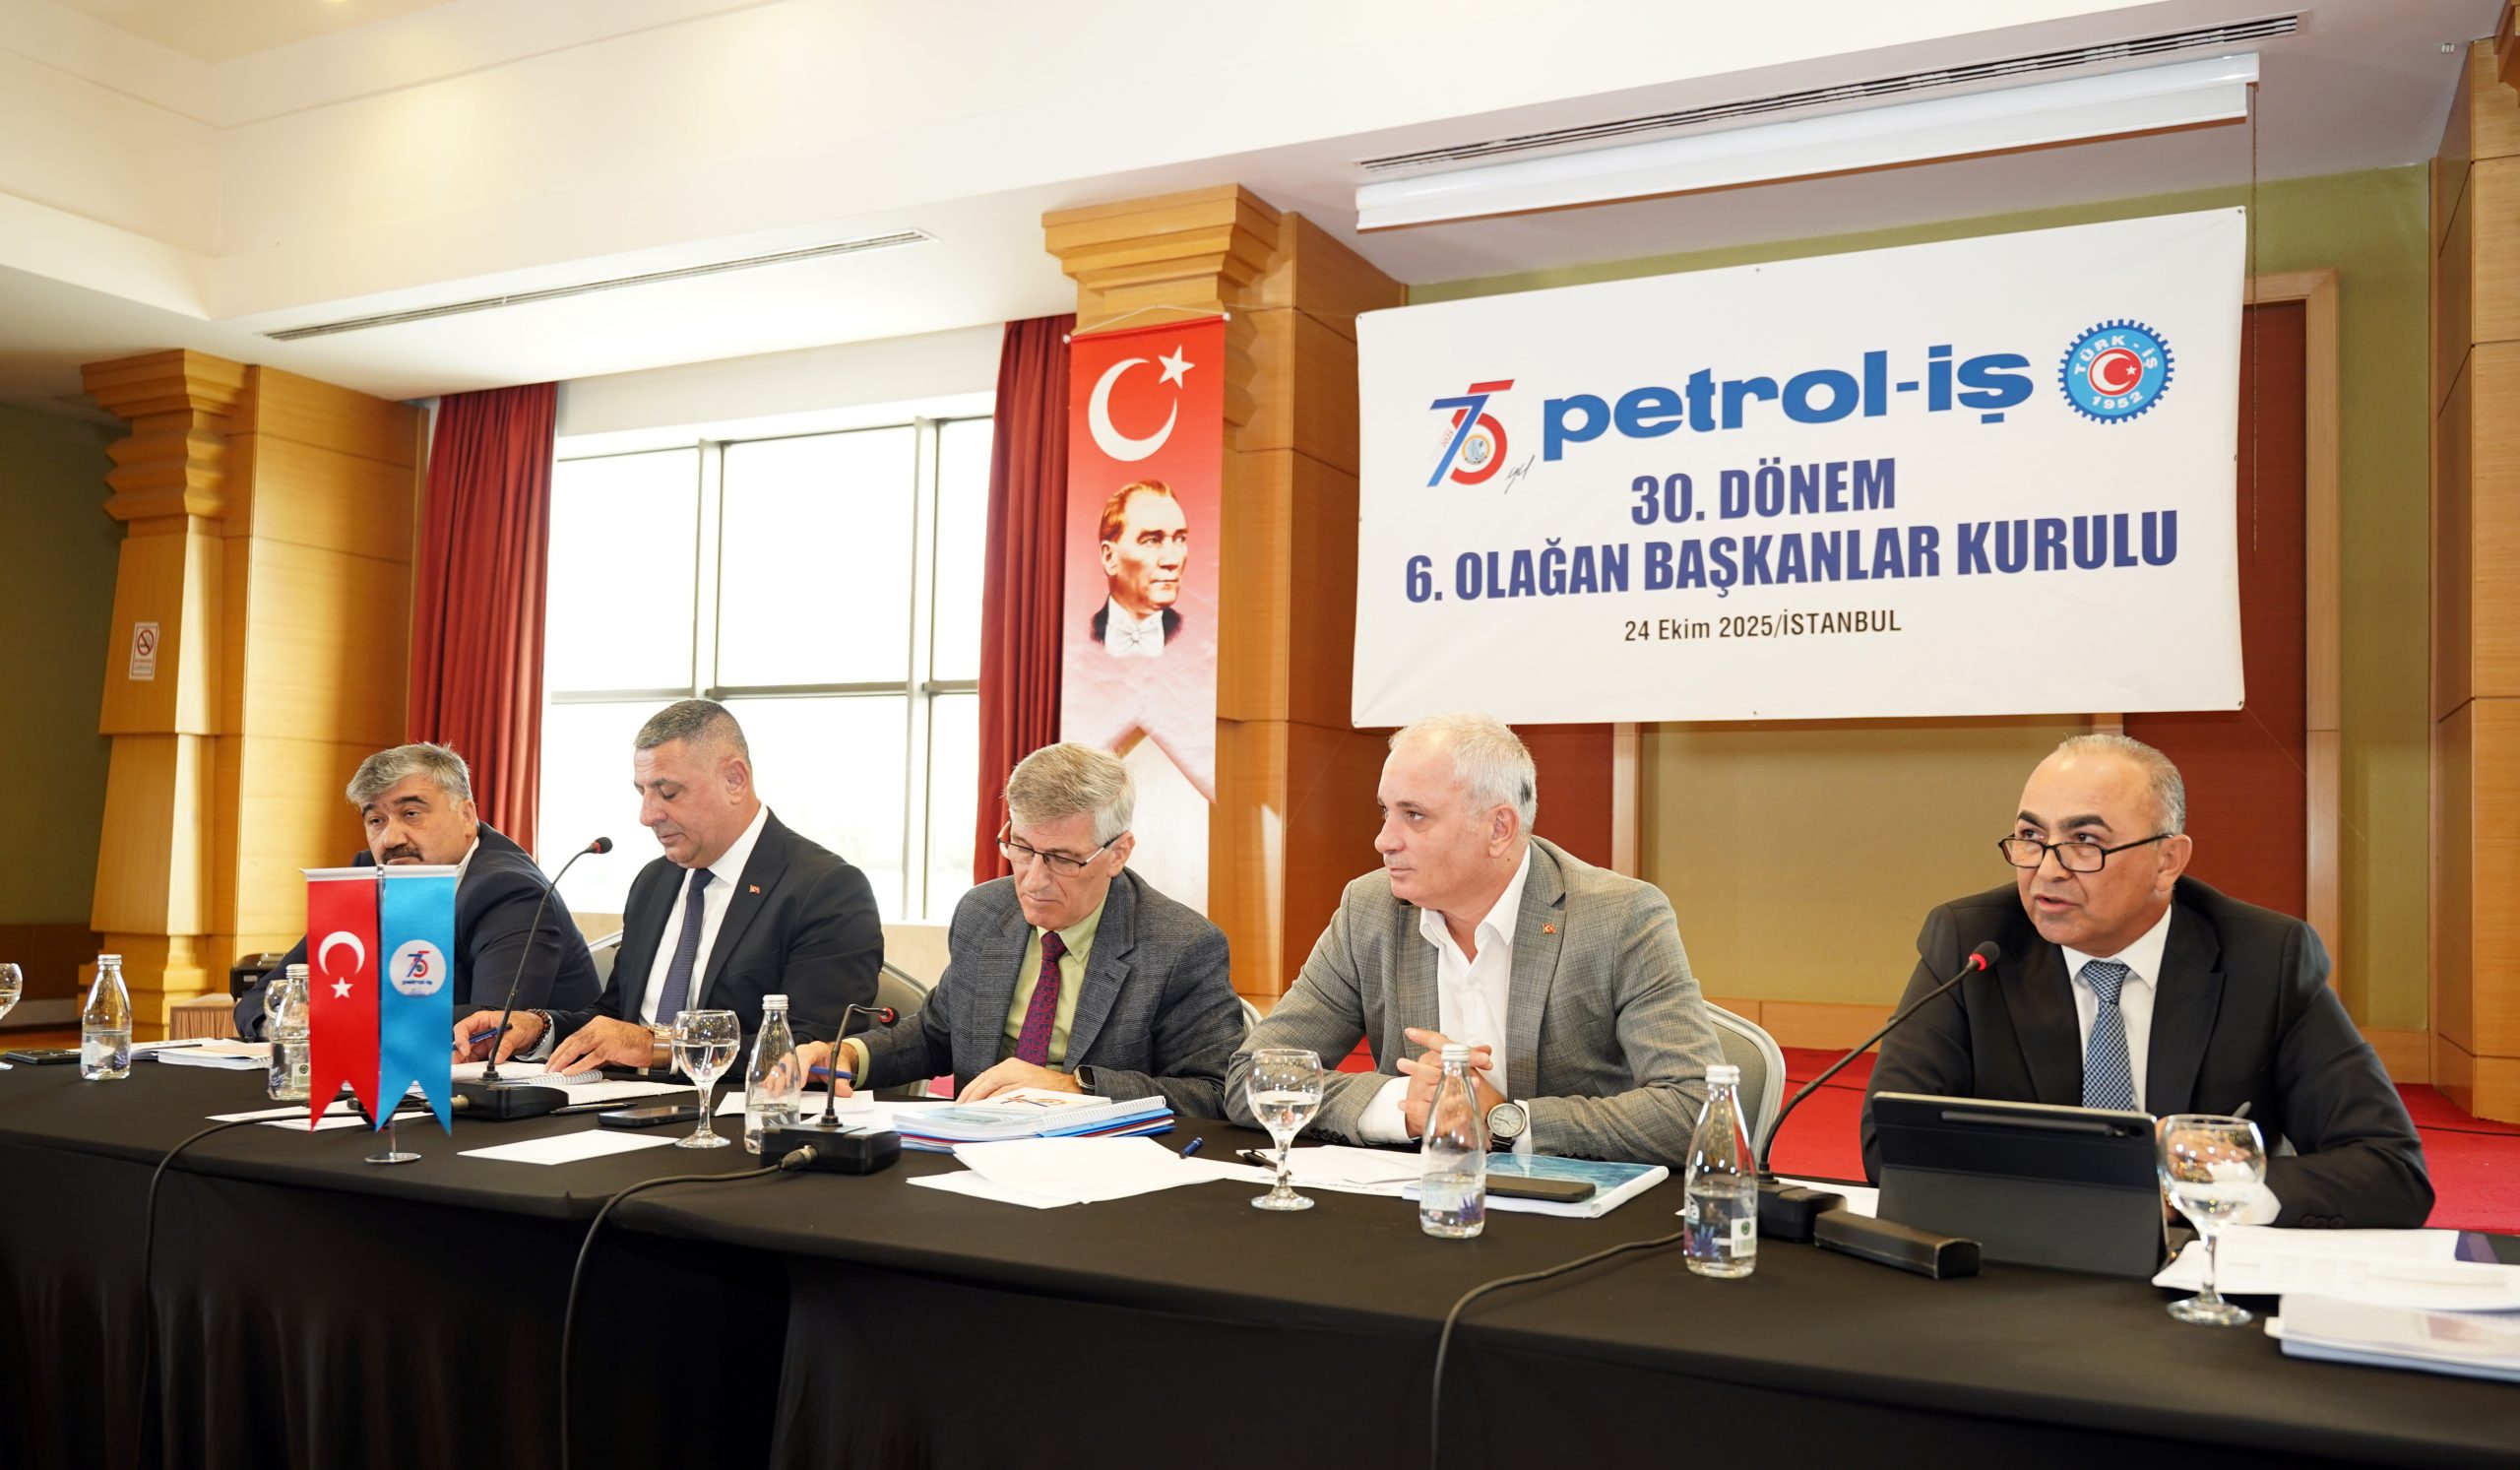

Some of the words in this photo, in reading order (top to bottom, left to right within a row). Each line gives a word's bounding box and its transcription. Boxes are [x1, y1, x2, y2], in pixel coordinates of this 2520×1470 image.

[1426, 379, 1515, 486] 75
[1543, 345, 2034, 461] petrol-iş
[2092, 391, 2143, 410] 1952
[1632, 473, 1706, 525] 30.
[1720, 457, 1896, 519] DÖNEM
[1405, 553, 1443, 603] 6.
[1456, 538, 1629, 601] OLAĞAN
[1645, 526, 1940, 598] BAŞKANLAR
[1957, 510, 2178, 575] KURULU
[1624, 620, 1651, 641] 24
[1659, 618, 1711, 640] Ekim
